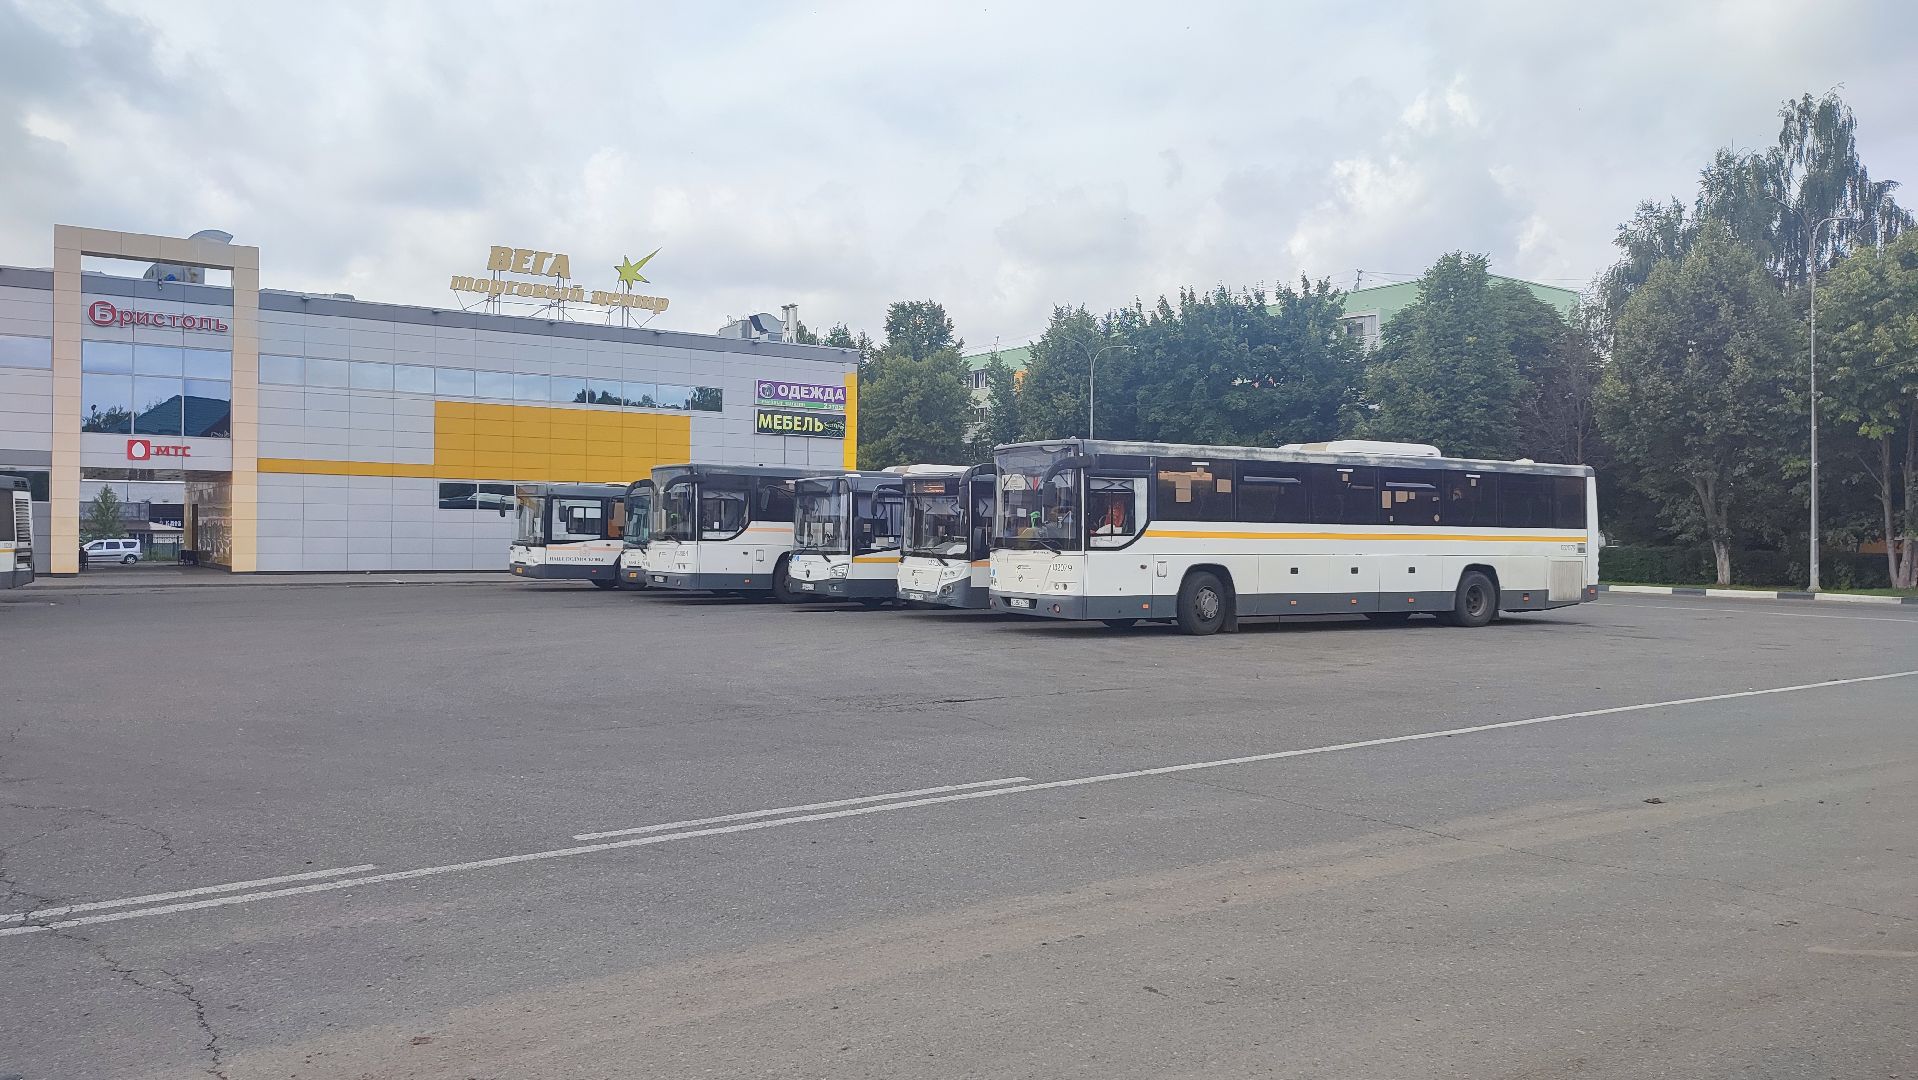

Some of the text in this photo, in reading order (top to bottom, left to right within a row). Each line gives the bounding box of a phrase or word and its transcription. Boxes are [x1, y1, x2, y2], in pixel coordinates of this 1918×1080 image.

[487, 246, 571, 279] ВЕГА
[88, 300, 229, 332] Бристоль
[777, 384, 845, 402] ОДЕЖДА
[759, 413, 824, 432] МЕБЕЛЬ
[155, 445, 191, 457] МТС
